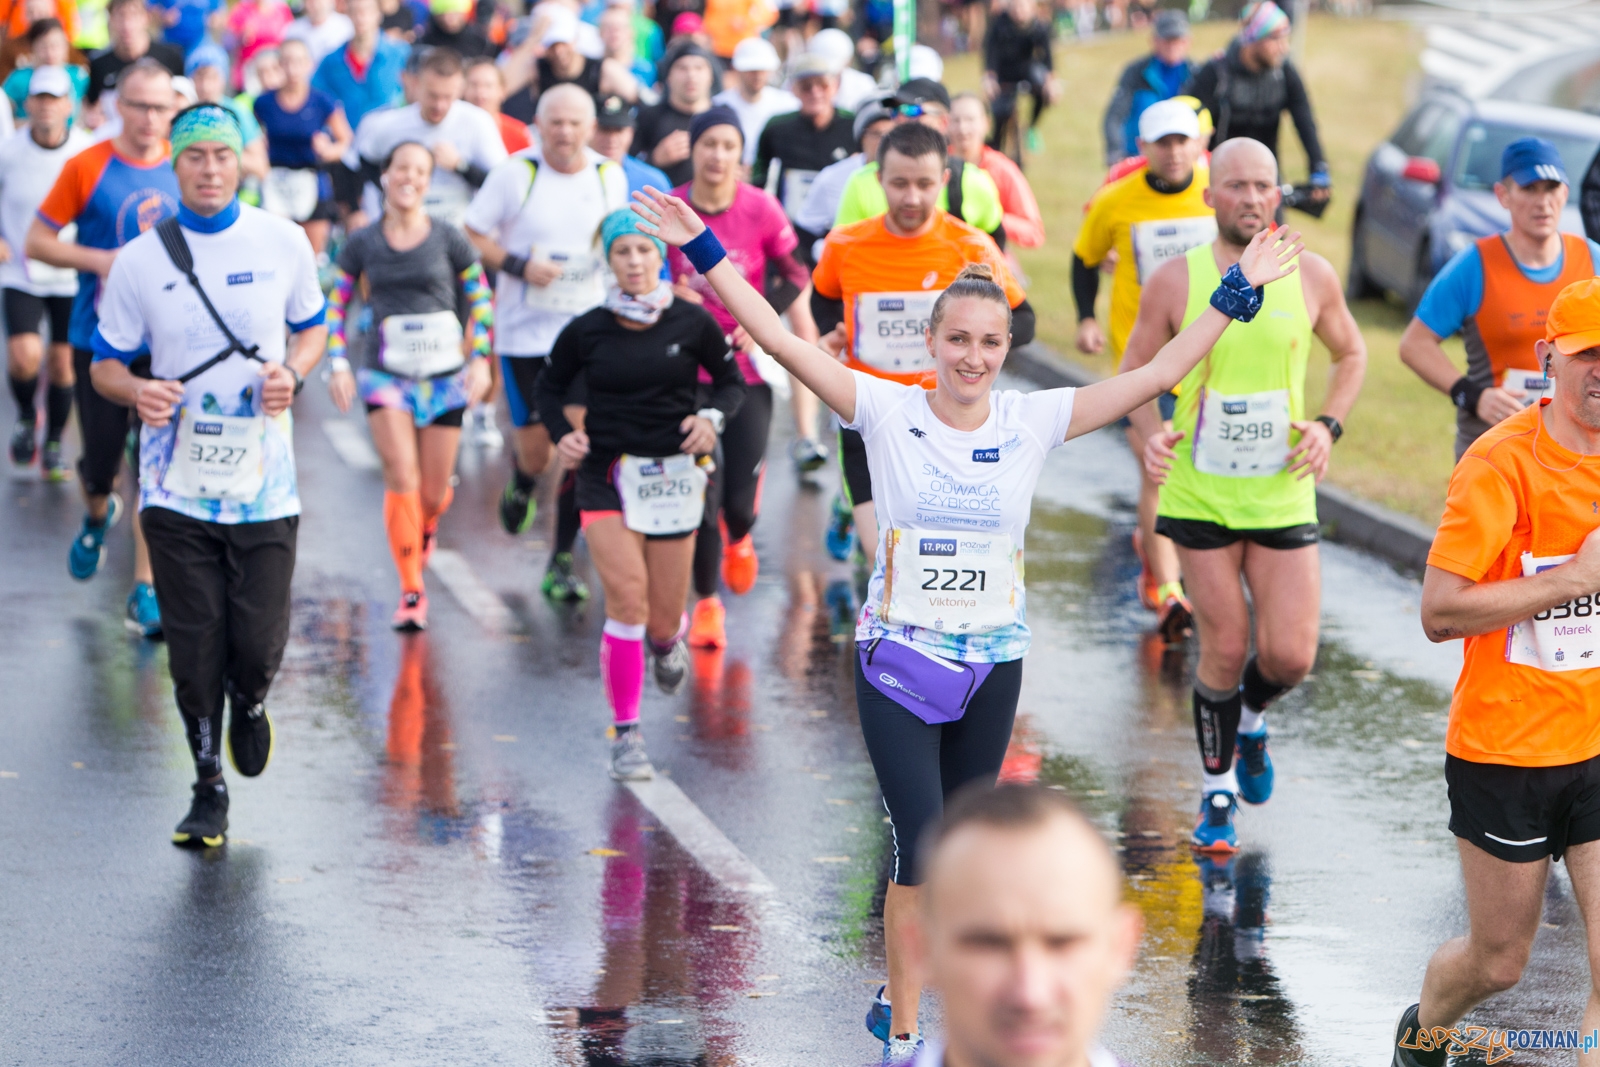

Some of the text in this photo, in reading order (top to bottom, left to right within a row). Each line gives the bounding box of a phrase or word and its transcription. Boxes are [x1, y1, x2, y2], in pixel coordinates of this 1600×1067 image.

[1218, 421, 1273, 441] 3298
[189, 443, 247, 465] 3227
[638, 480, 691, 500] 6526
[930, 480, 1000, 496] ODWAGA
[917, 492, 1001, 511] SZYBKOŚĆ
[924, 514, 978, 526] października
[980, 519, 1000, 528] 2016
[935, 542, 954, 552] PKO
[921, 568, 986, 591] 2221
[929, 597, 977, 608] Viktoriya
[1554, 625, 1592, 636] Marek
